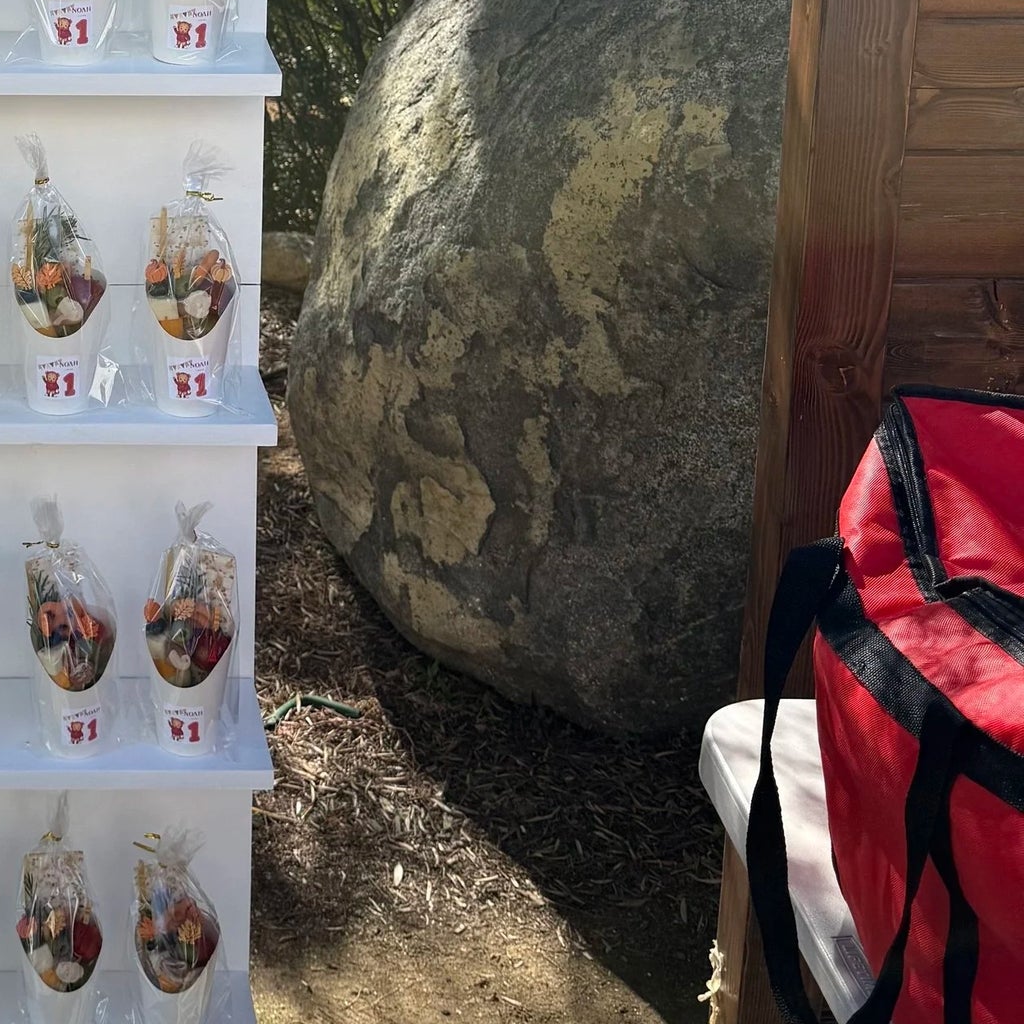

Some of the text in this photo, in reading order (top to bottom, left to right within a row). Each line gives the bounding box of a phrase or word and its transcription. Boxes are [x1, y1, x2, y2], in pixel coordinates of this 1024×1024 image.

[71, 6, 92, 14] NOAH
[192, 10, 212, 19] NOAH
[76, 18, 89, 45] 1
[195, 23, 207, 48] 1
[59, 360, 78, 368] NOAH
[190, 360, 209, 369] NOAH
[63, 372, 76, 396] 1
[194, 373, 207, 397] 1
[87, 718, 97, 741] 1
[187, 721, 200, 743] 1
[841, 942, 877, 997] LIFETIM
